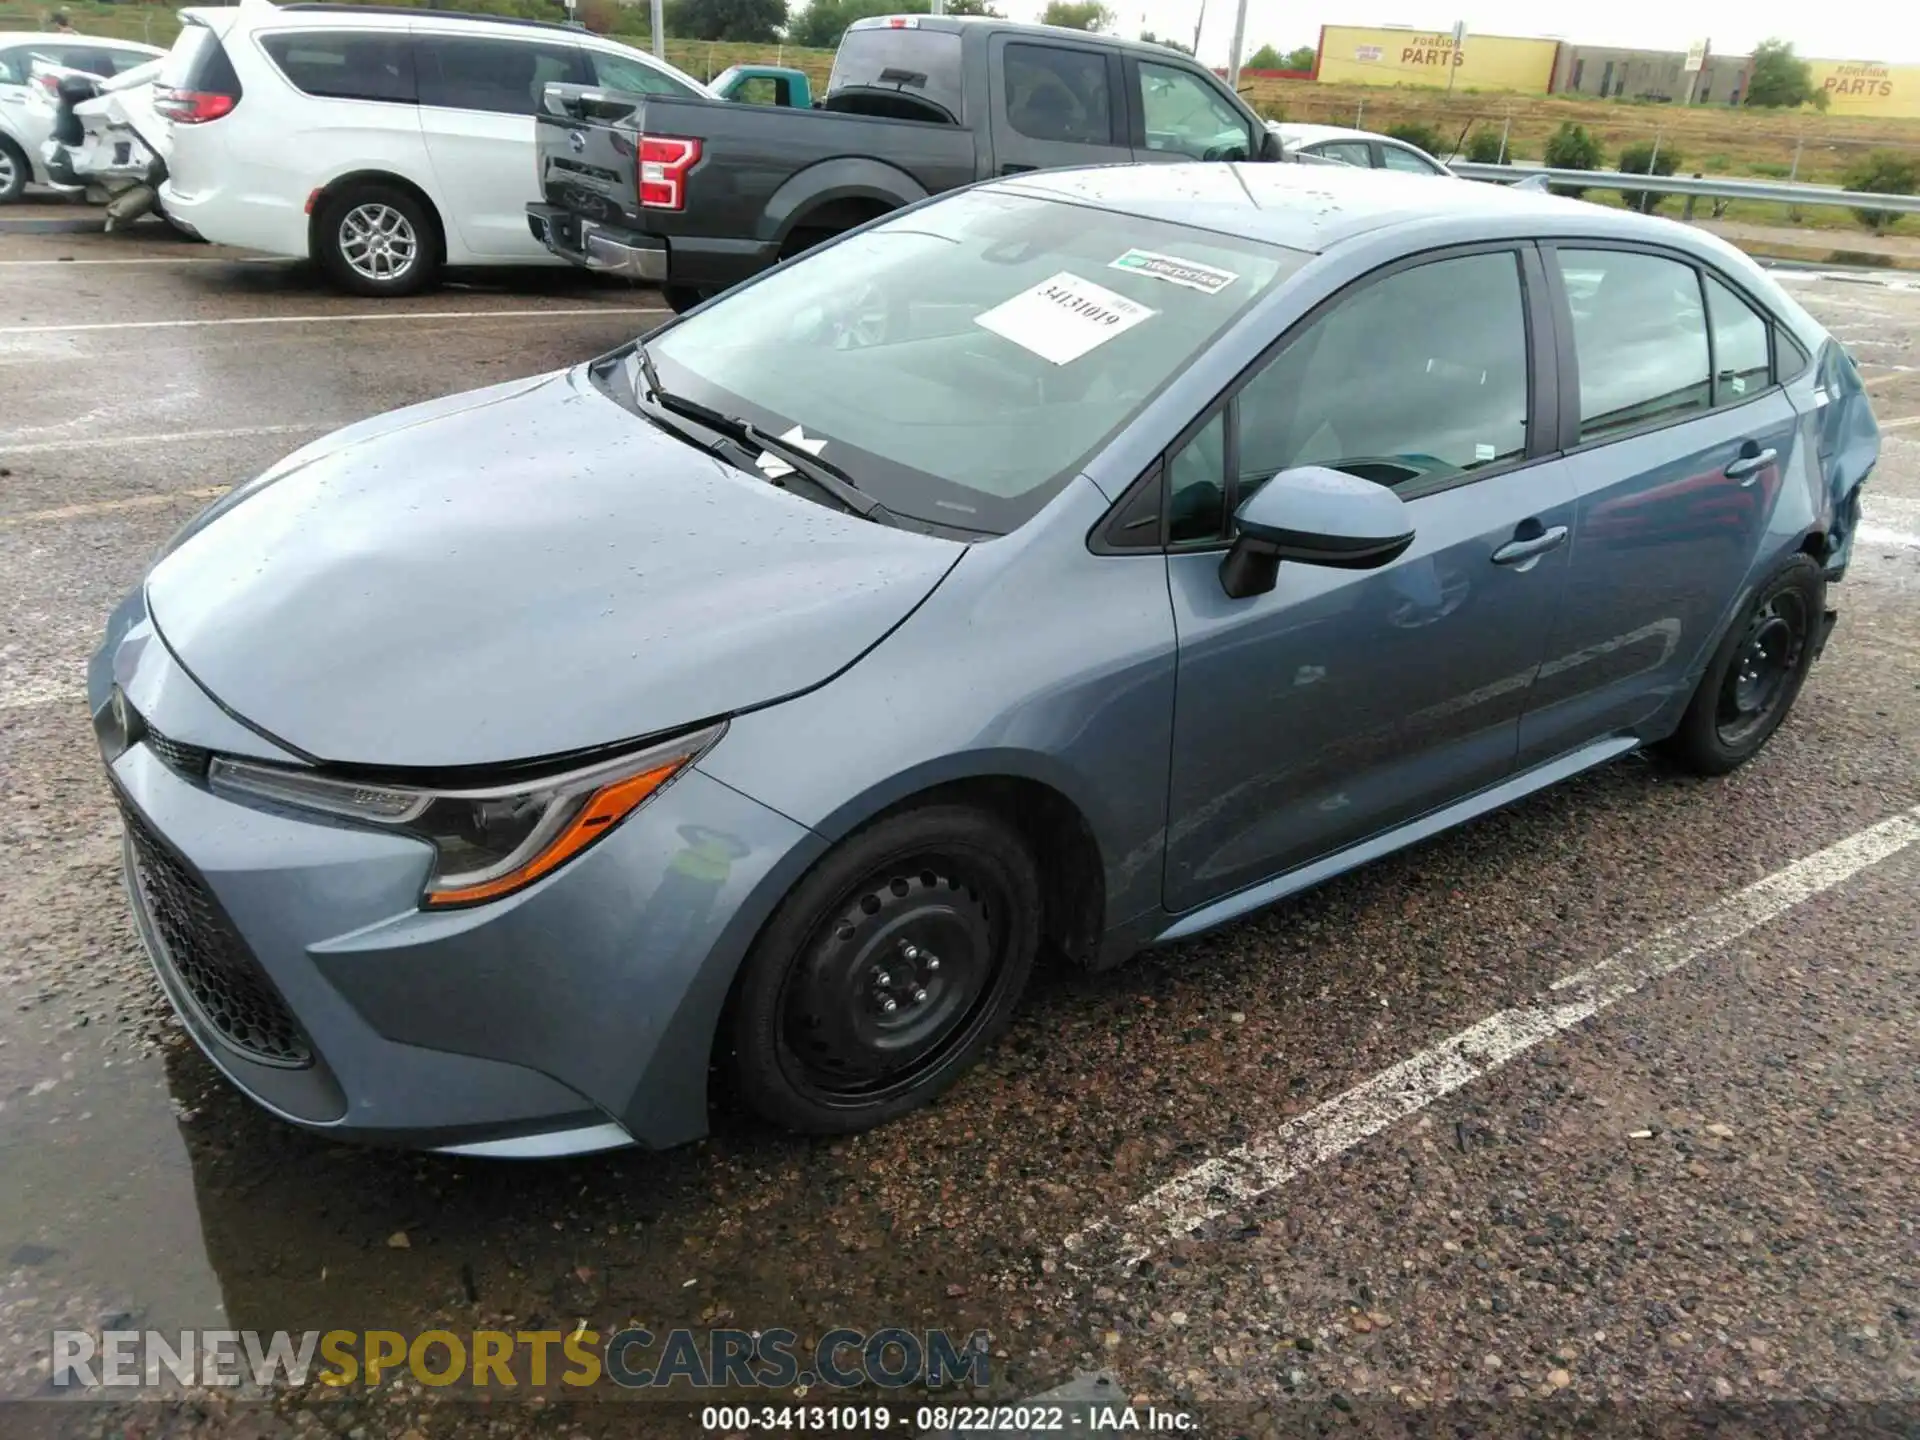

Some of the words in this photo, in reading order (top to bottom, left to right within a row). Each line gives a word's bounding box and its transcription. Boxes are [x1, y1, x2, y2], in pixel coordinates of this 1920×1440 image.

[1401, 48, 1464, 67] PARTS
[1823, 77, 1893, 97] PARTS
[1037, 286, 1120, 325] 34131019
